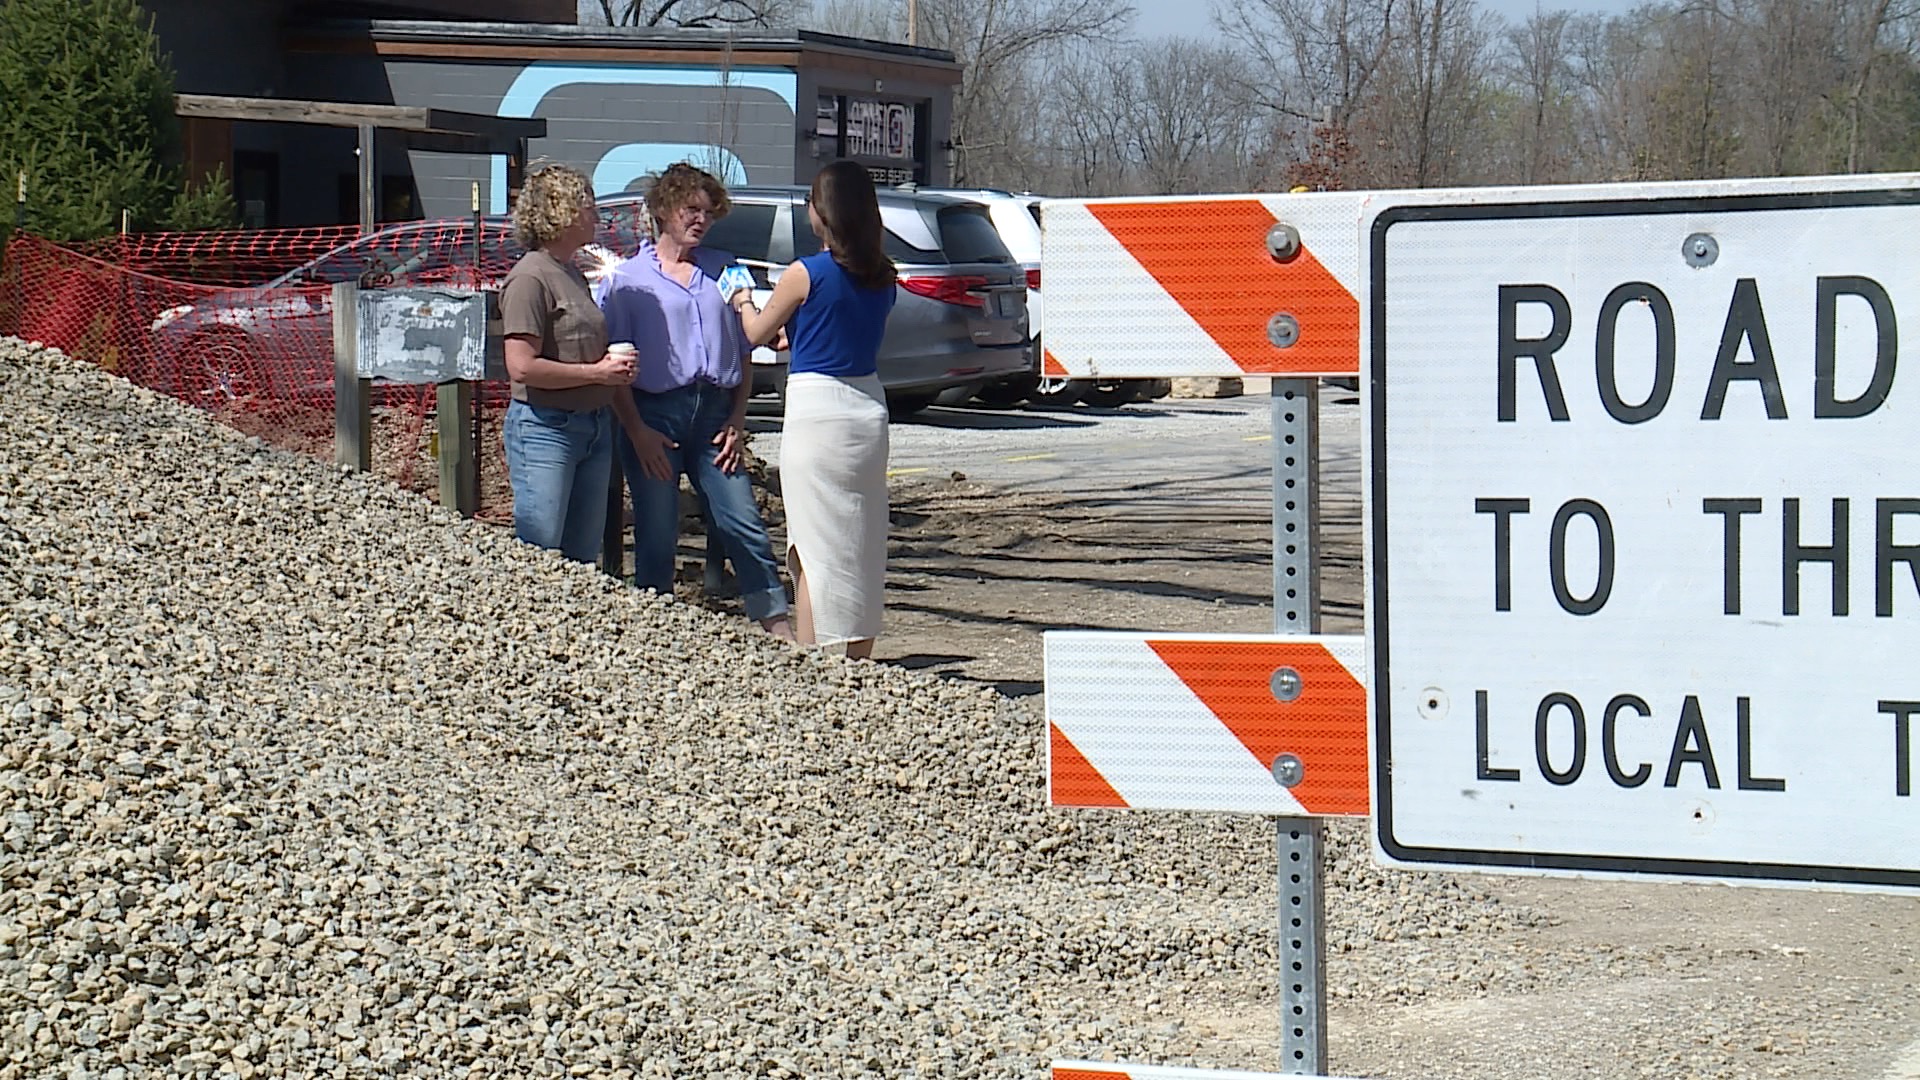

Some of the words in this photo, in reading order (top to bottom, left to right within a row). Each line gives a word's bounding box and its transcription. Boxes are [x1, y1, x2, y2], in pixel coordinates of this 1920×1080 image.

[851, 101, 914, 158] STATION
[1498, 276, 1898, 424] ROAD
[1475, 498, 1615, 616] TO
[1475, 690, 1786, 793] LOCAL
